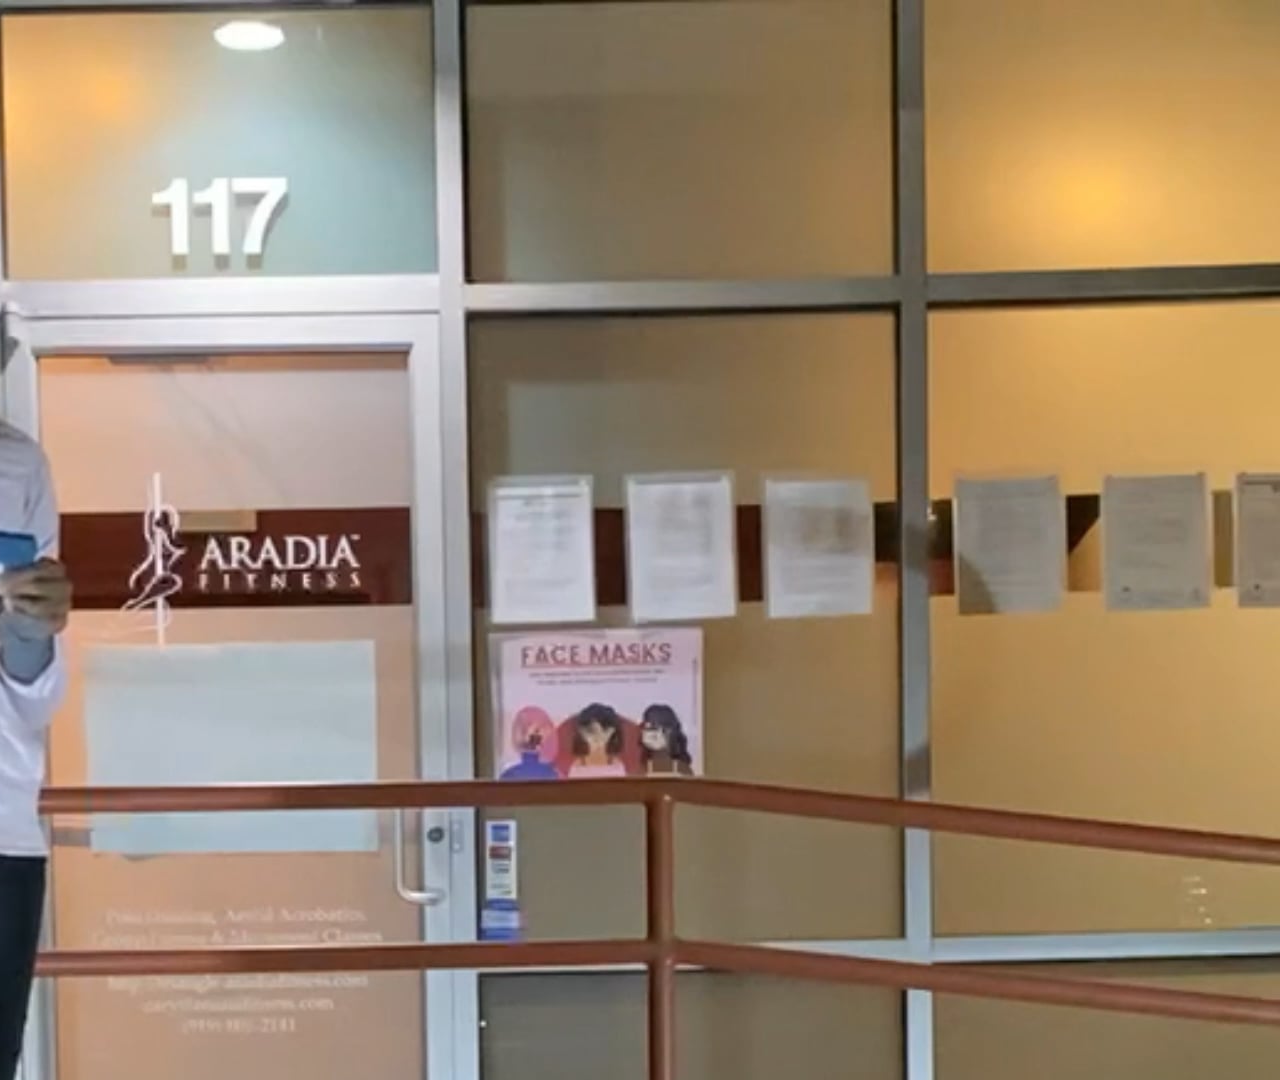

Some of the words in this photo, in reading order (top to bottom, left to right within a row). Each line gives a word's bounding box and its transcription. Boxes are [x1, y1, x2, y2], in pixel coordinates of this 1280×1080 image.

[151, 177, 288, 255] 117
[200, 534, 361, 570] ARADIA
[198, 572, 361, 592] FITNESS
[521, 645, 581, 666] FACE
[589, 642, 672, 665] MASKS
